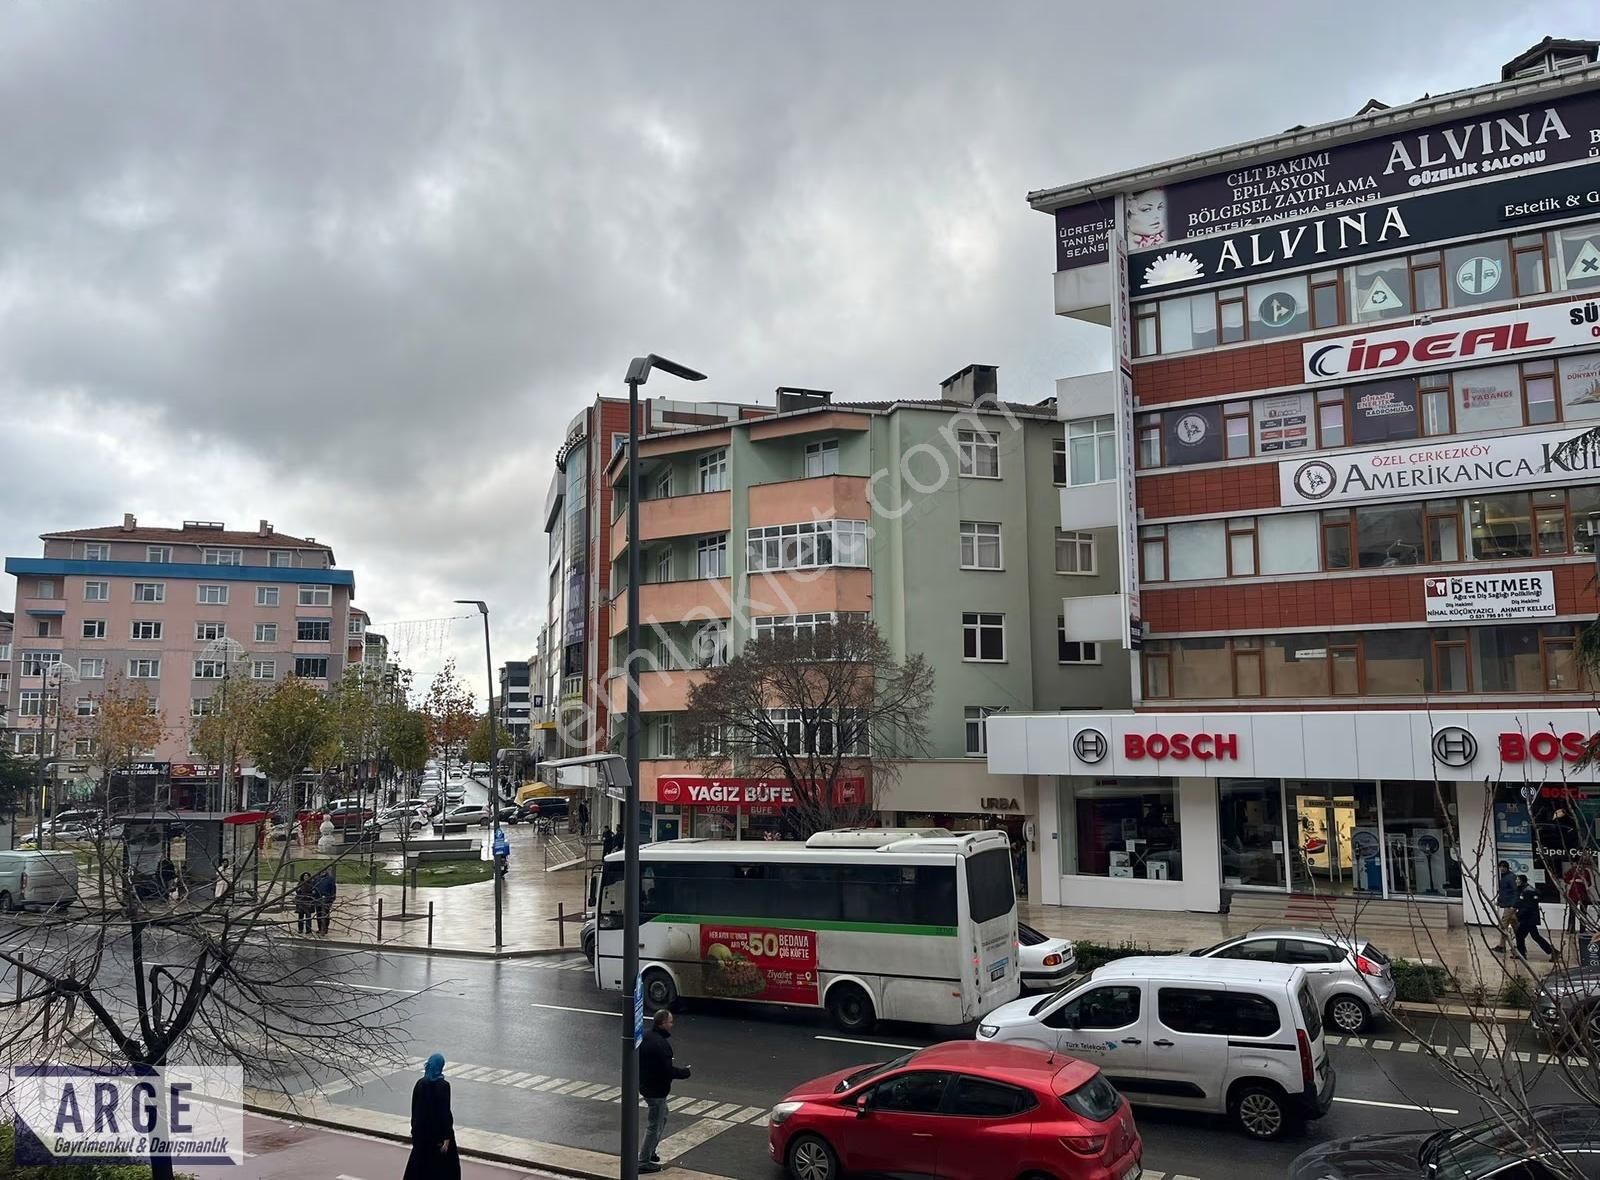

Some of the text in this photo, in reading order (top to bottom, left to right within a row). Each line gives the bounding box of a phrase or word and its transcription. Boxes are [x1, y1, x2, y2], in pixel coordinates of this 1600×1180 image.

[1382, 108, 1571, 176] ALVINA
[1265, 152, 1331, 180] BAKIMI
[1408, 150, 1546, 187] GÜZELLİK SALONU
[1188, 175, 1378, 227] BÖLGESEL ZAYIFLAMA
[1504, 197, 1561, 217] Estetik
[1566, 194, 1581, 207] &
[1186, 218, 1253, 238] ÜCRETSİZ
[1325, 192, 1381, 210] SEANSI
[1059, 218, 1114, 238] ÜCRETSİZ
[1062, 232, 1110, 248] TANIŞMA
[1066, 243, 1108, 258] SEANSI
[1215, 206, 1411, 273] ALVINA
[1347, 322, 1556, 372] İDEAL
[1371, 445, 1492, 467] ÖZEL ÇERKEZKÖY
[1451, 578, 1543, 594] DENTMER
[1124, 733, 1238, 761] BOSCH
[687, 782, 795, 803] YAĞIZ BÜFE
[980, 797, 1020, 811] URBA
[779, 934, 809, 948] BEDAVA
[790, 948, 810, 959] KÖFTE
[1065, 1041, 1107, 1050] Türk Telekom
